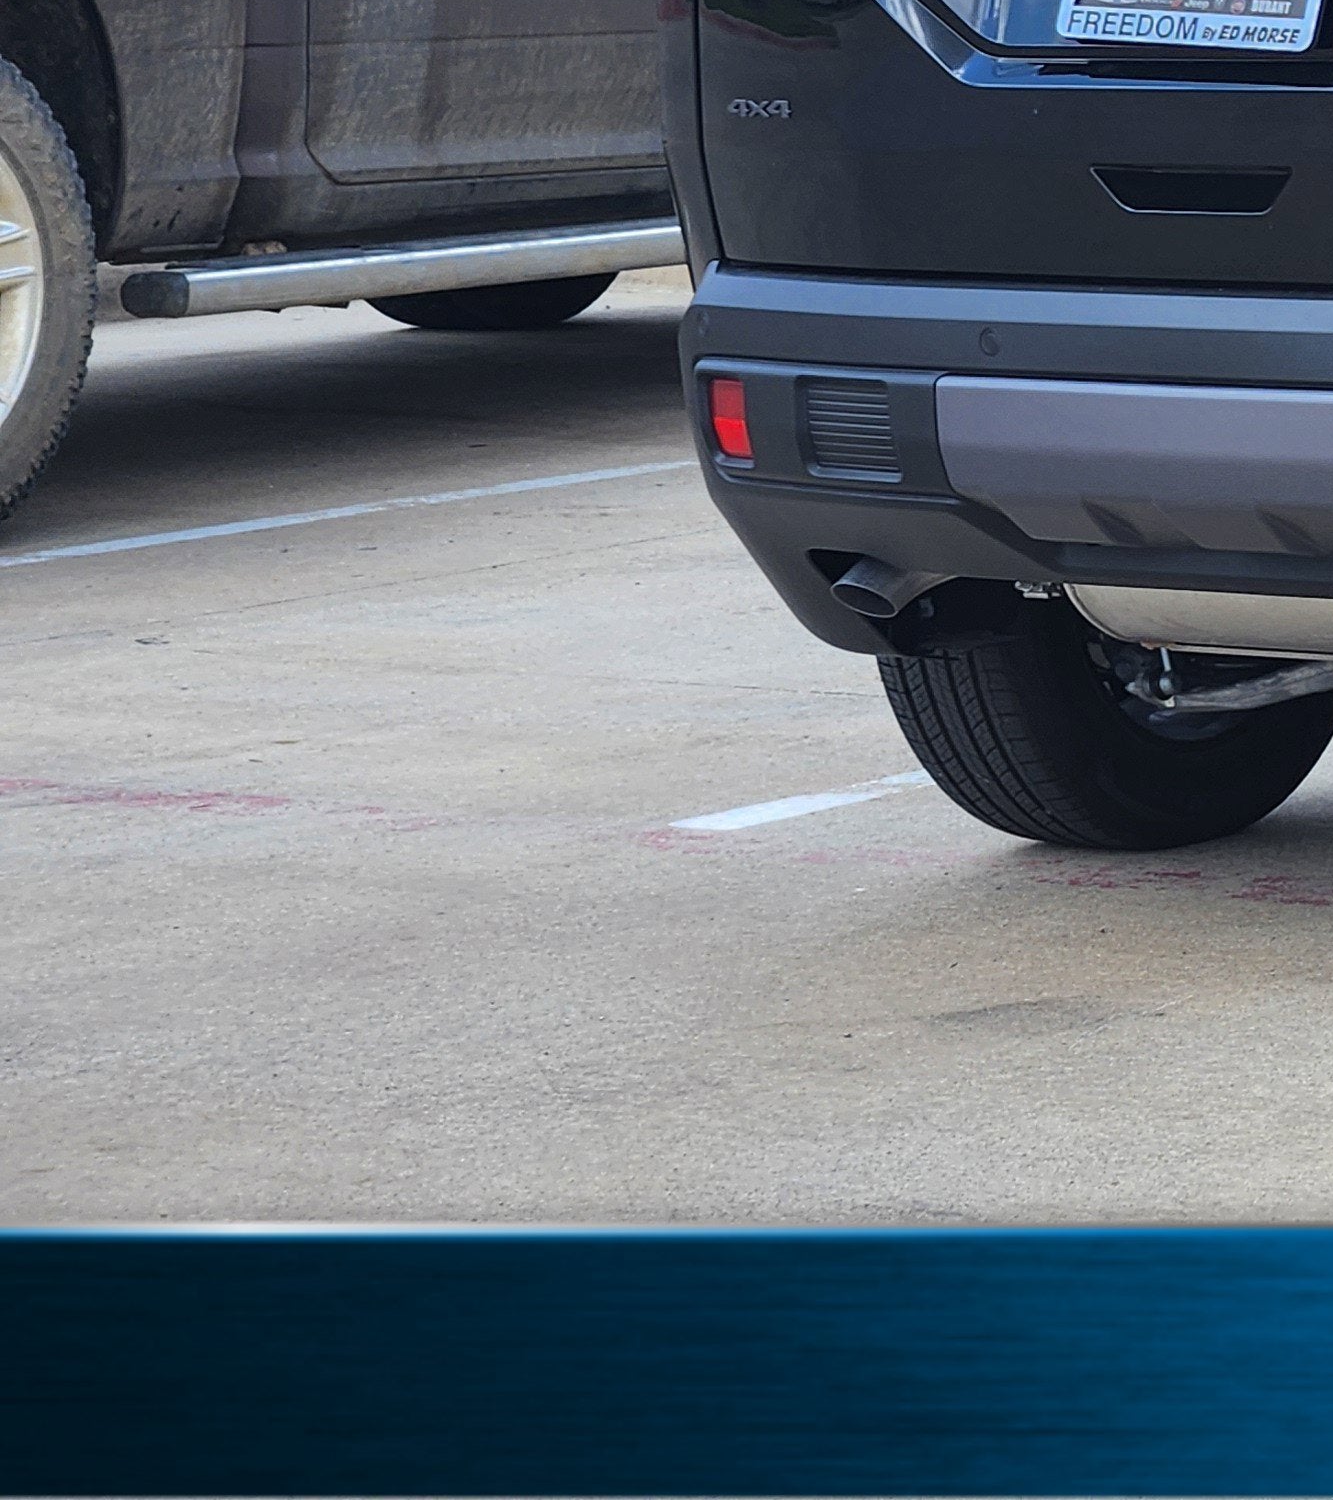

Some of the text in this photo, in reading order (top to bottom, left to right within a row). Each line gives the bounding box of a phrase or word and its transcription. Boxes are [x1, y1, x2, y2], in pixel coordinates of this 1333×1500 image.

[1066, 9, 1199, 41] FREEDOM
[1219, 24, 1241, 40] ED
[1241, 26, 1301, 44] MORSE
